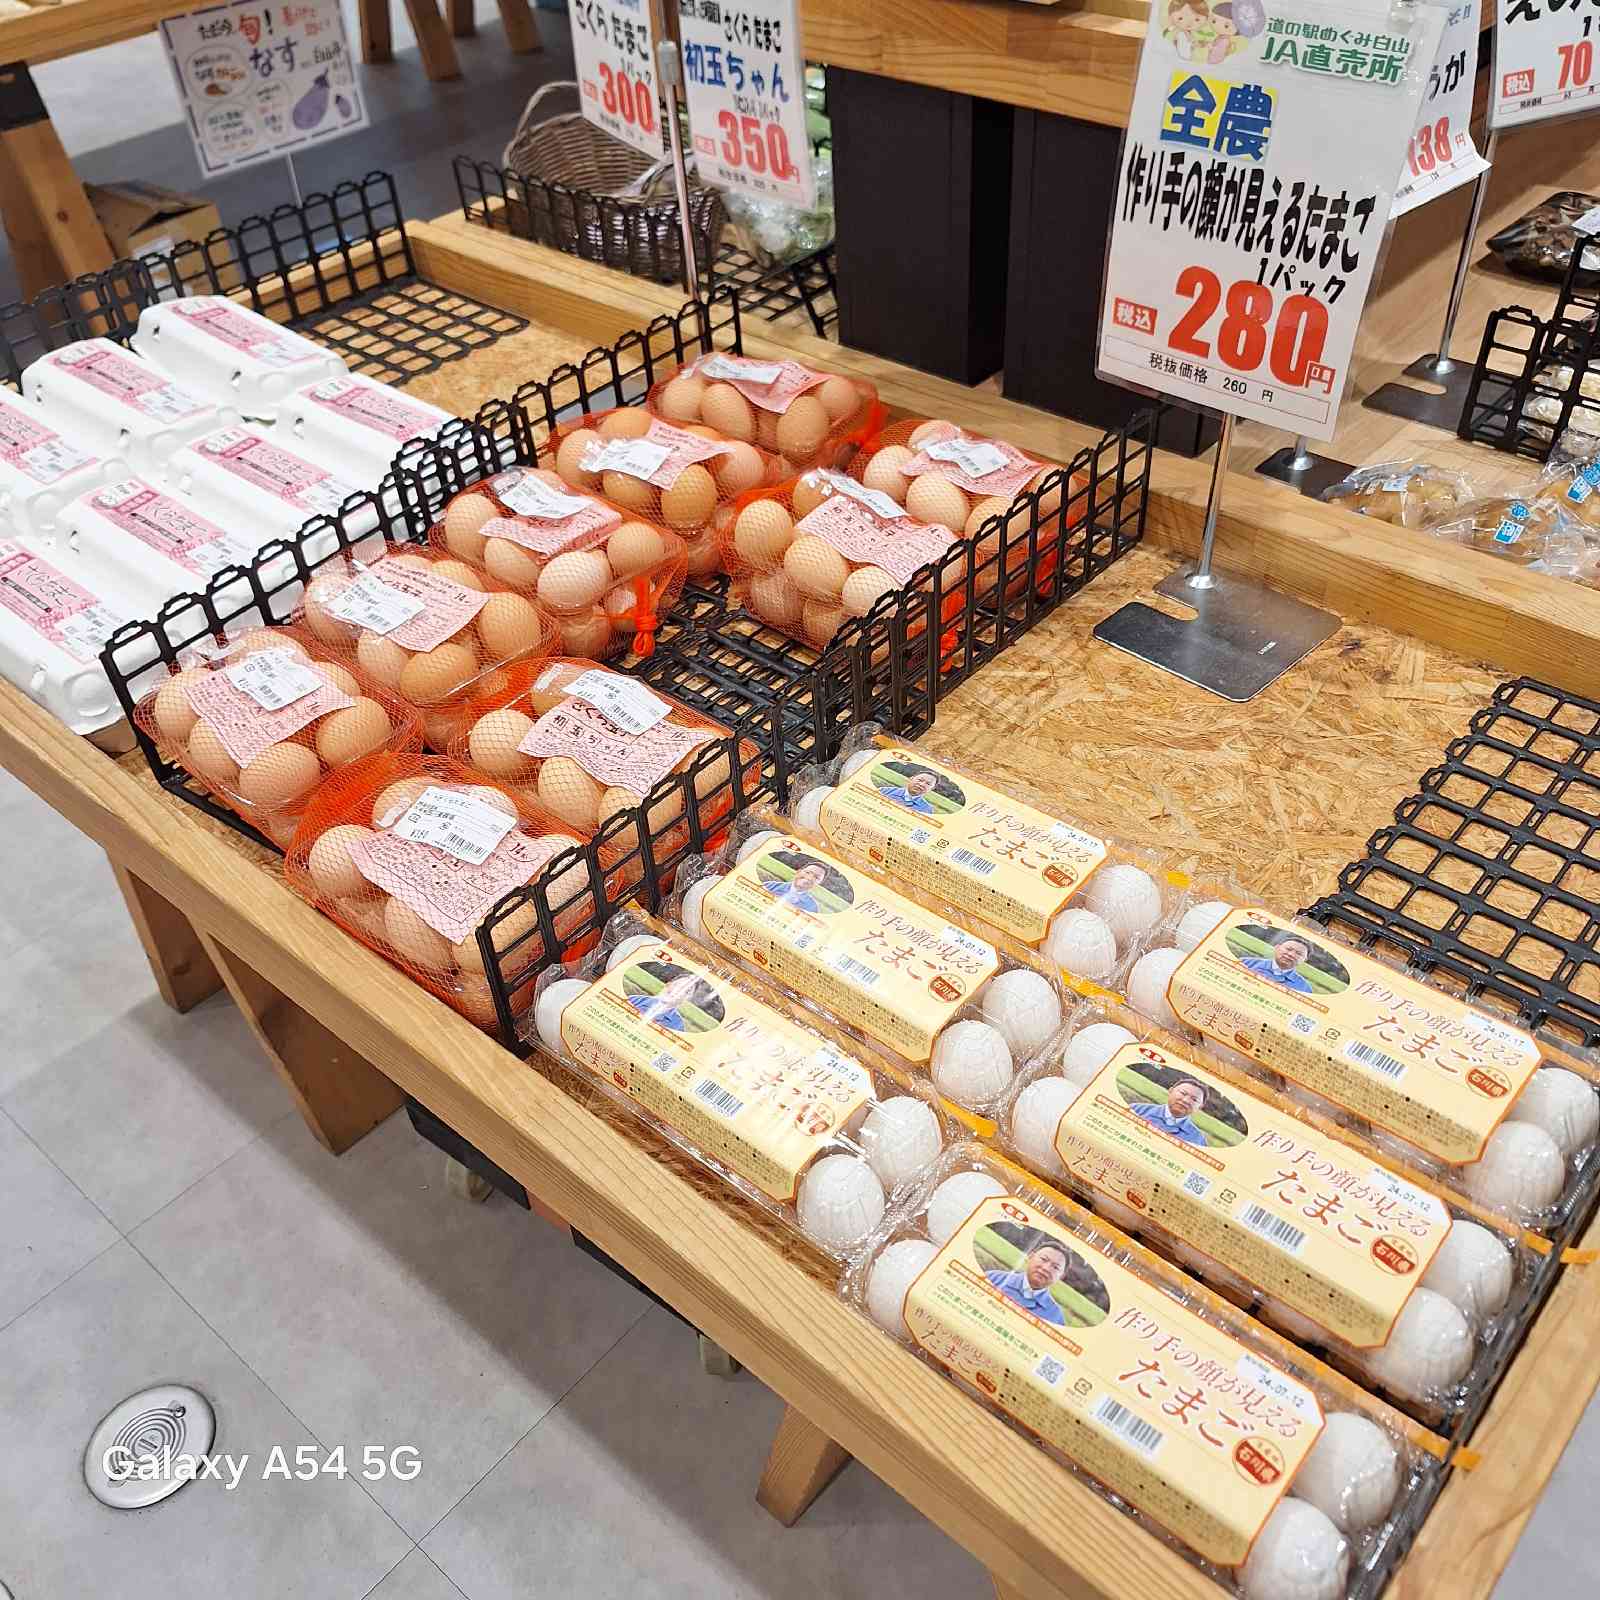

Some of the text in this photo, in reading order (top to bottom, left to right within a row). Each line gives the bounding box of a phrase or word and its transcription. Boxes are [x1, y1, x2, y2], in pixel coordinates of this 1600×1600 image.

[249, 36, 297, 77] なす
[1261, 36, 1404, 82] JA直売所
[1267, 17, 1410, 54] 道の駅めぐみ白山
[1558, 41, 1593, 90] 70
[599, 62, 654, 134] 300
[684, 39, 789, 103] 初玉ちゃん
[718, 109, 790, 182] 350
[1159, 73, 1275, 162] 全農
[1407, 116, 1452, 178] 138
[1256, 257, 1346, 304] 1パック
[1115, 265, 1336, 394] 税込 280 円
[1148, 352, 1273, 403] 税抜価格 260 円
[968, 827, 1060, 870] たまご
[853, 929, 948, 981] たまご
[854, 900, 984, 975] 作り手の顔が見える
[1354, 979, 1524, 1067] 作り手の顔が見える
[1363, 1014, 1483, 1074] たまご
[1253, 1129, 1431, 1238] 作り手の顔が見える
[1261, 1169, 1389, 1244] たまご
[1387, 1185, 1432, 1212] 24.07.12
[1113, 1306, 1304, 1438] 作り手の顔が見える
[1118, 1357, 1256, 1447] たまご
[1258, 1374, 1305, 1409] 24.07.12
